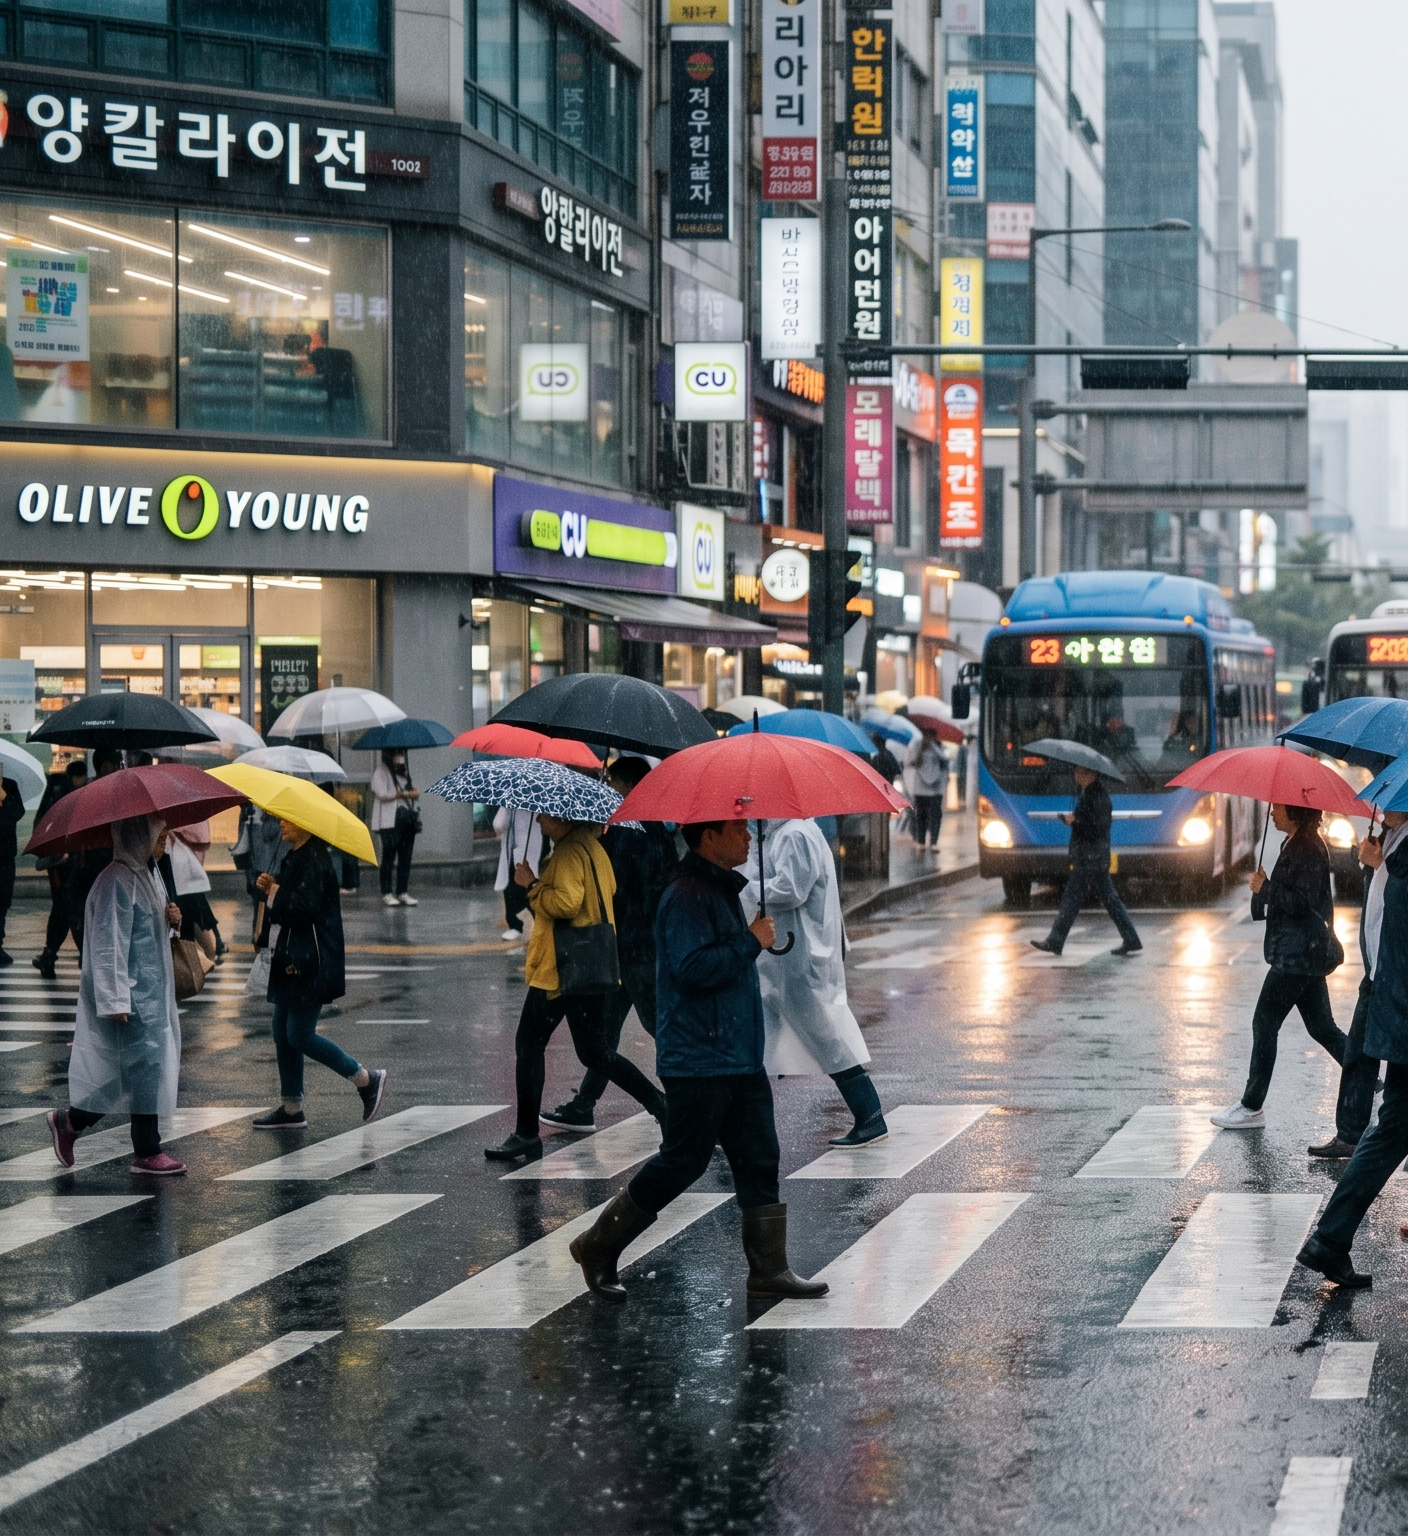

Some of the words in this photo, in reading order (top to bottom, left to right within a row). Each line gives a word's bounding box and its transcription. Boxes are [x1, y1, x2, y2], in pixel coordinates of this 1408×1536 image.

[775, 15, 808, 126] 리아리
[26, 94, 366, 192] 양칼라이전
[854, 216, 883, 340] 아어먼원
[695, 371, 726, 387] CU
[19, 482, 152, 525] OLIVE
[226, 490, 370, 533] YOUNG
[561, 511, 587, 558] CU
[696, 537, 712, 574] CU
[1030, 639, 1060, 663] 23
